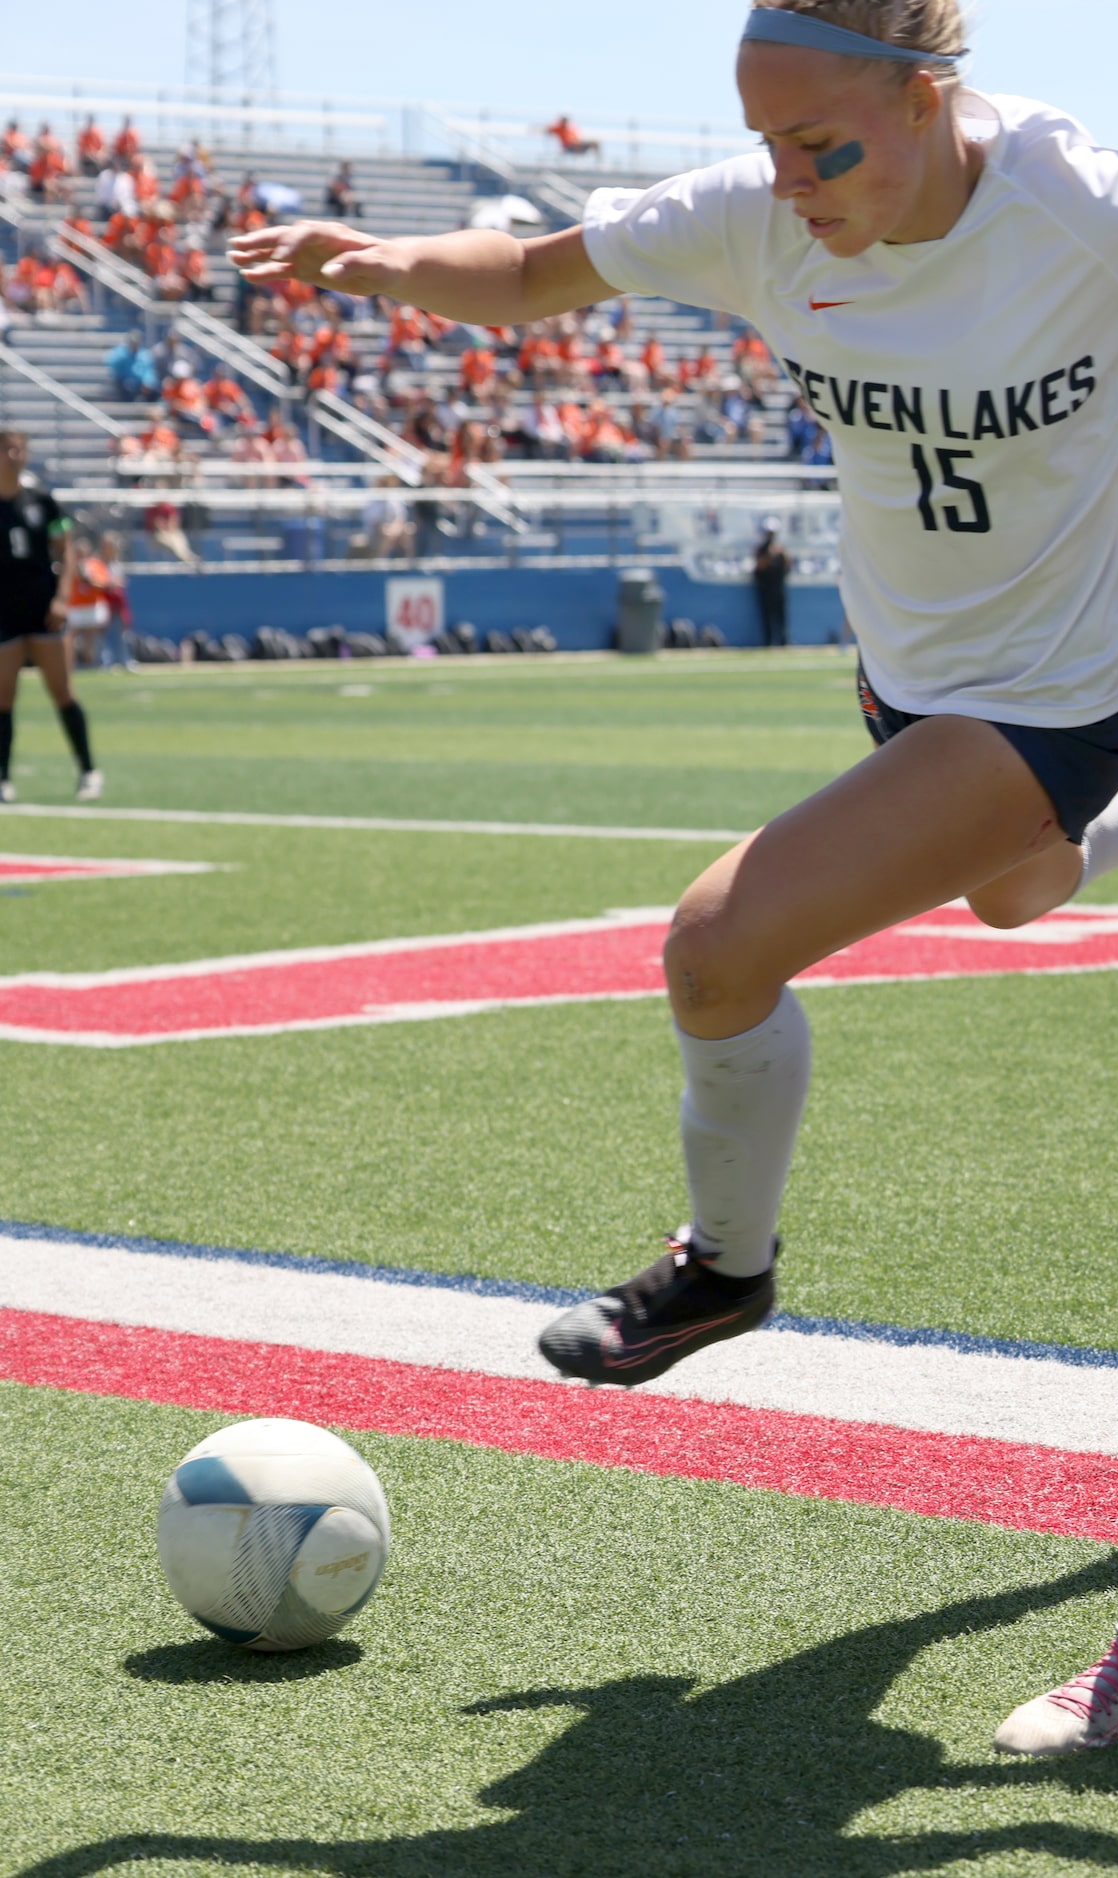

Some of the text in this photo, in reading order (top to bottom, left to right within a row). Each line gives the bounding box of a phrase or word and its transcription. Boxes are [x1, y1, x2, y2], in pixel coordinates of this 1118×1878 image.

[939, 355, 1096, 441] LAKES
[911, 443, 991, 533] 15
[395, 595, 436, 633] 40
